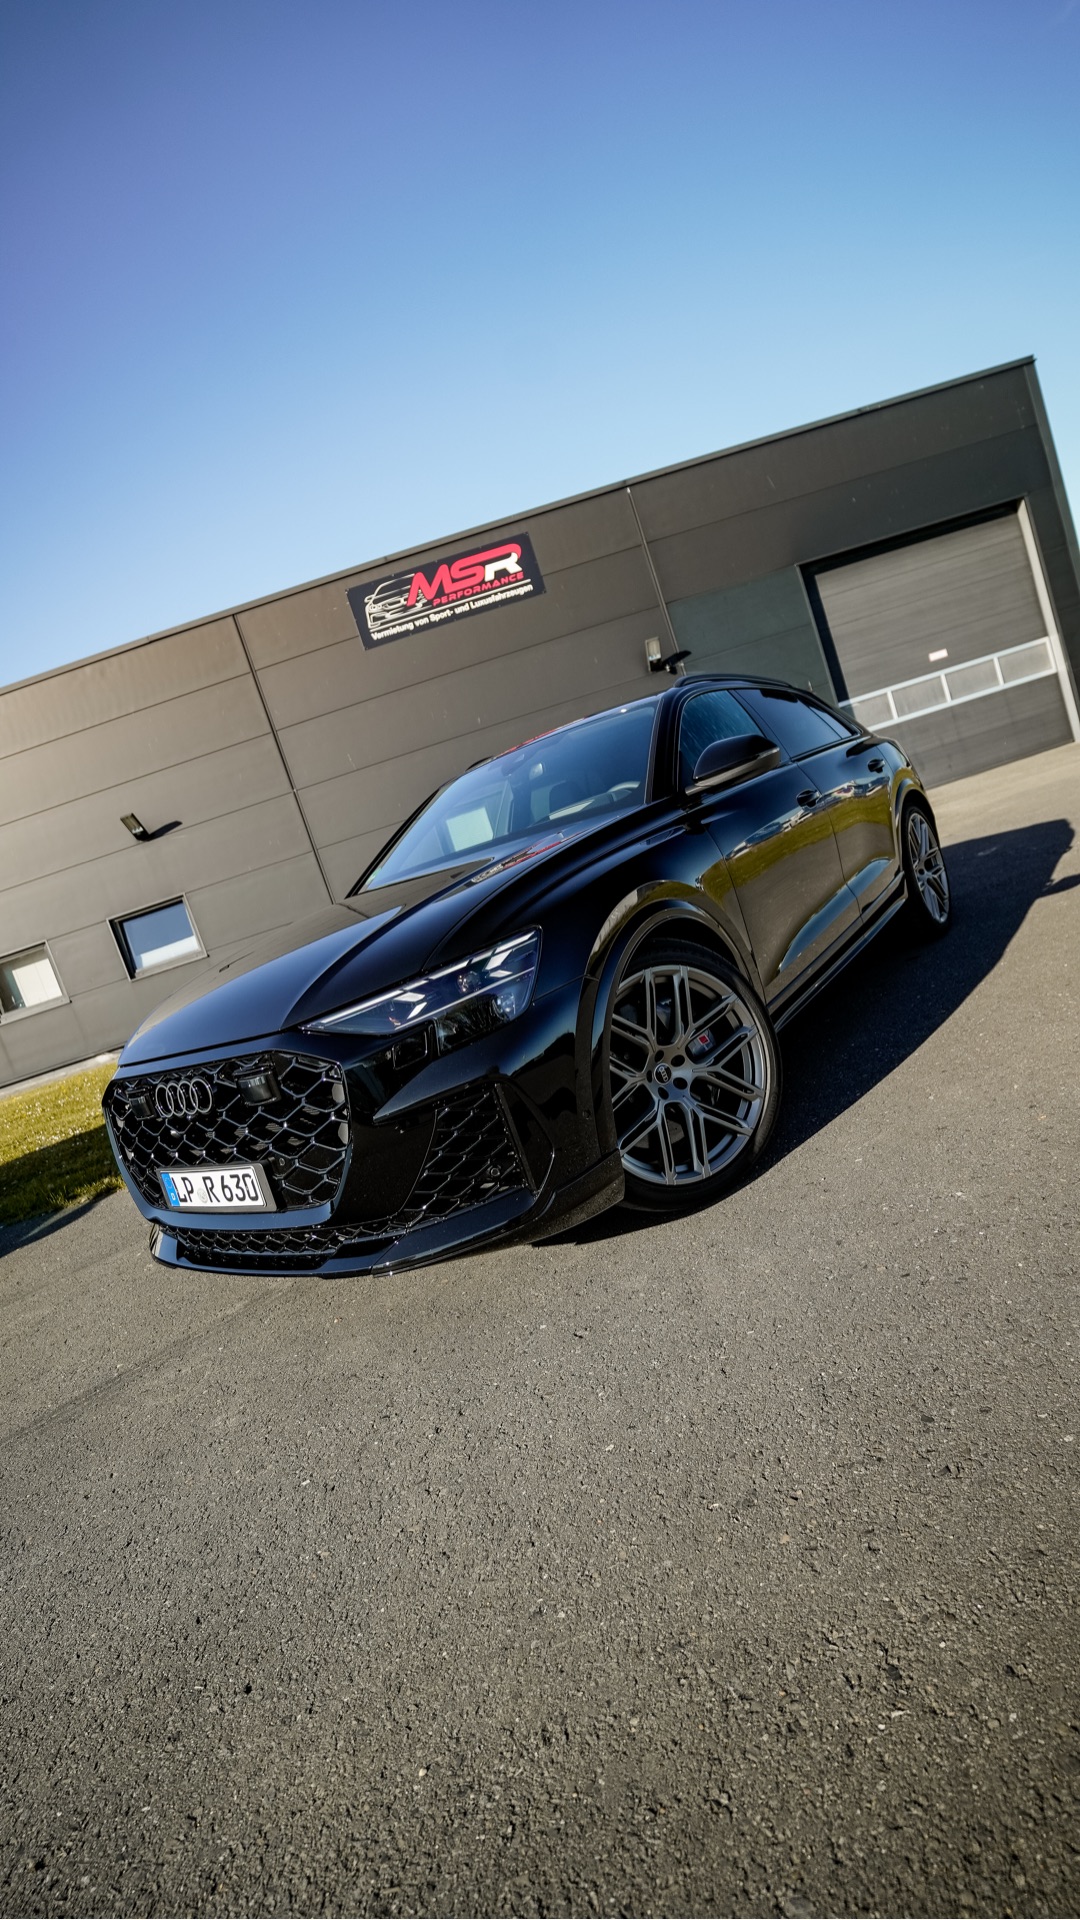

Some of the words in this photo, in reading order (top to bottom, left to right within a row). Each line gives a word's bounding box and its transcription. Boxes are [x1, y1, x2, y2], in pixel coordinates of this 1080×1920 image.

[406, 543, 523, 607] MSR
[433, 572, 524, 607] PERFORMANCE
[371, 621, 414, 640] Vermietung
[414, 616, 429, 627] von
[429, 608, 453, 622] Sport-
[454, 603, 470, 614] und
[470, 584, 533, 609] Luxusfahrzeugen
[172, 1176, 194, 1203] LP
[202, 1176, 220, 1203] R
[221, 1173, 259, 1202] 630
